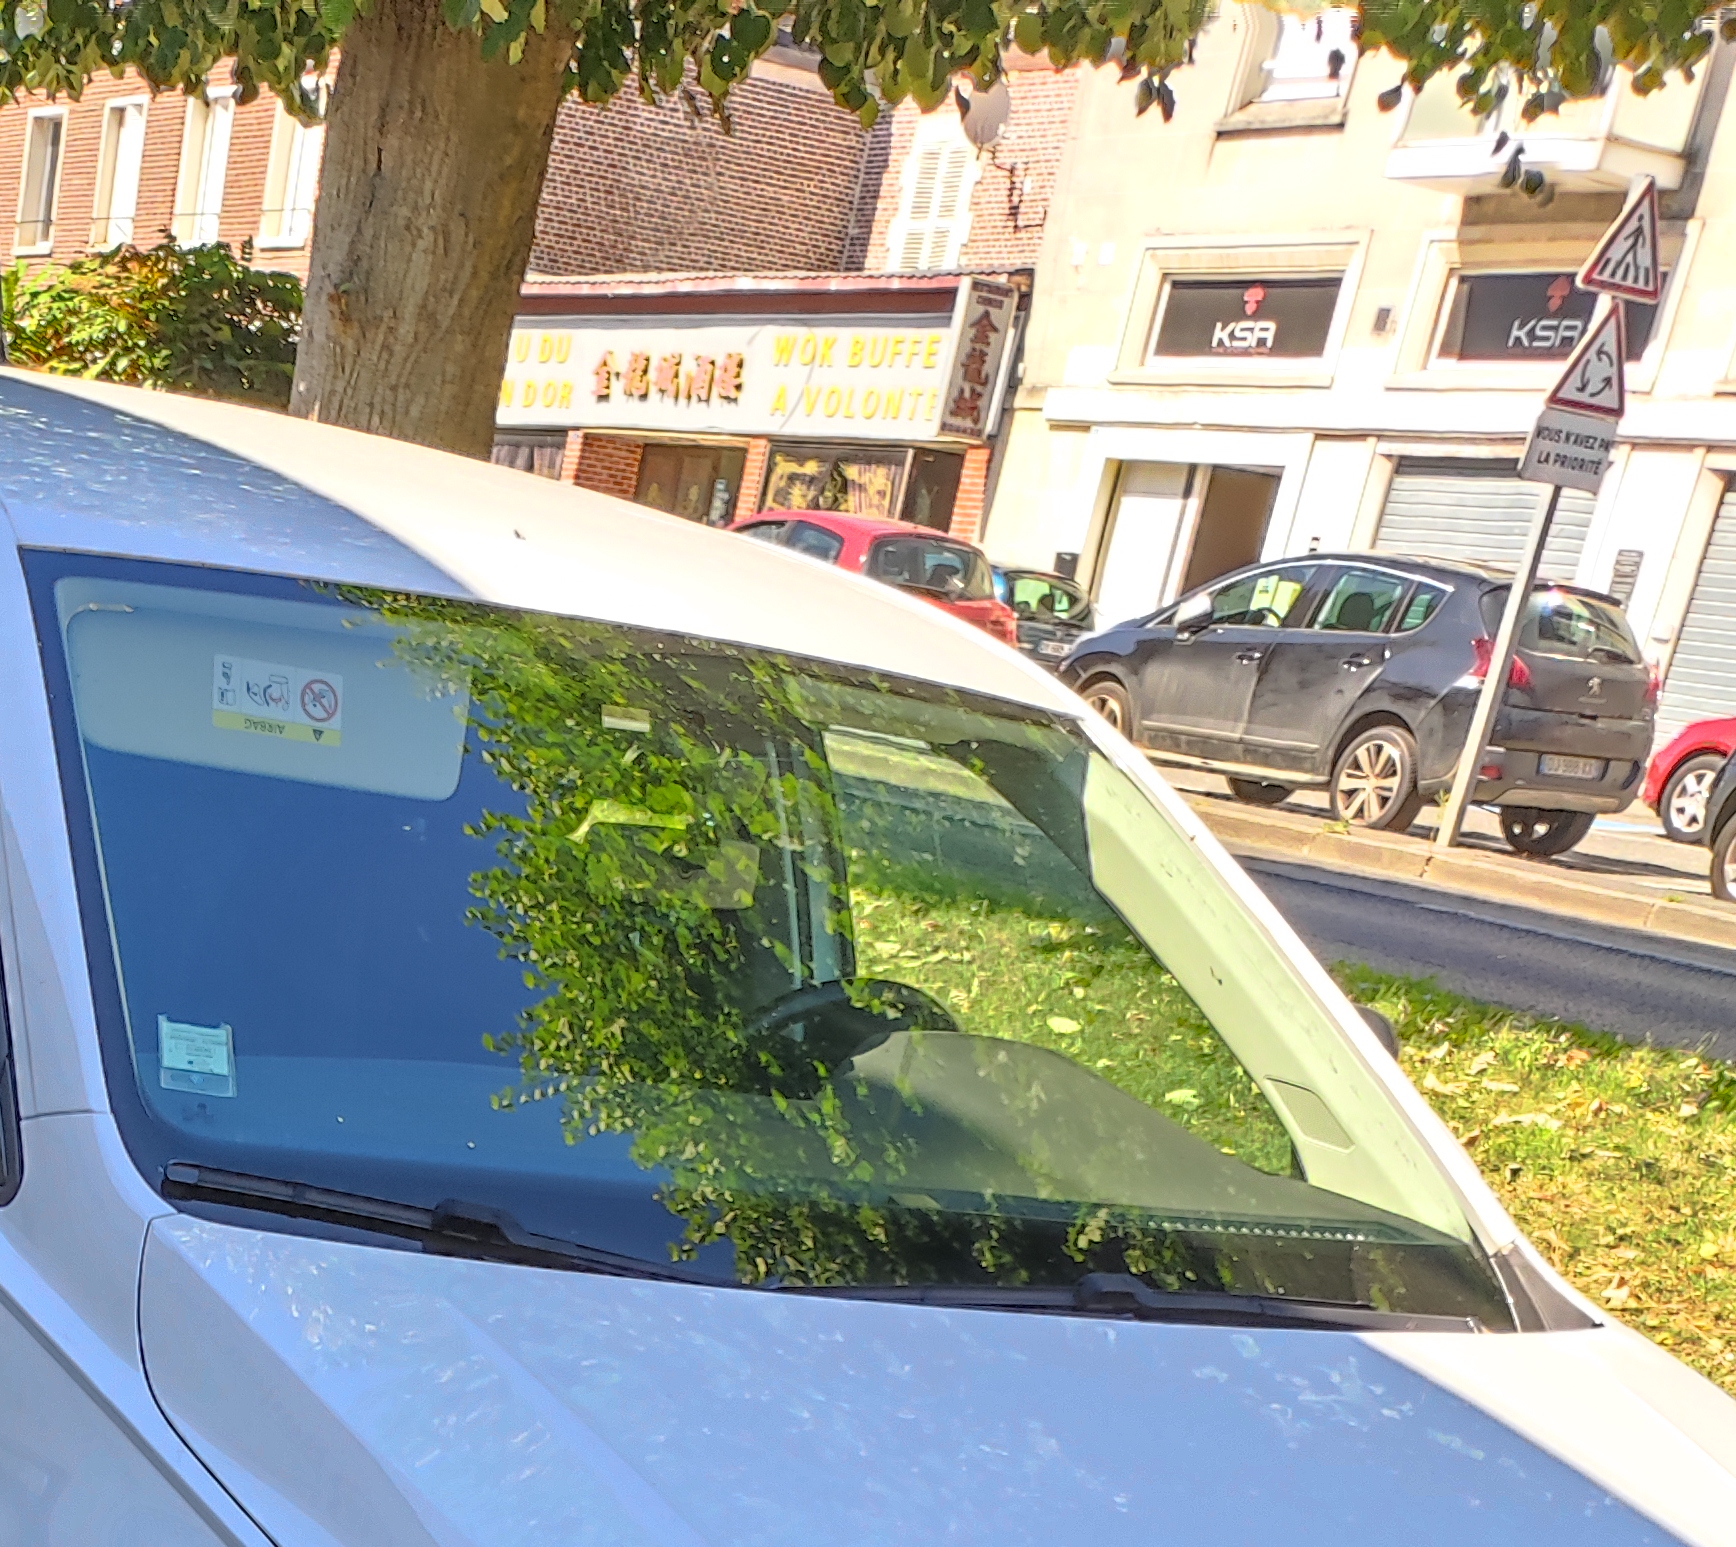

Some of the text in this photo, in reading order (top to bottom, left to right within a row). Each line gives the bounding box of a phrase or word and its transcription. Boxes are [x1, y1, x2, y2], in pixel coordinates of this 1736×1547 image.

[538, 333, 572, 364] DU
[773, 334, 943, 369] WOK BUFFE
[770, 384, 939, 420] A VOLONTE
[1536, 426, 1563, 444] VOUS
[1537, 450, 1551, 465] LA
[244, 718, 285, 735] AIRBAG
